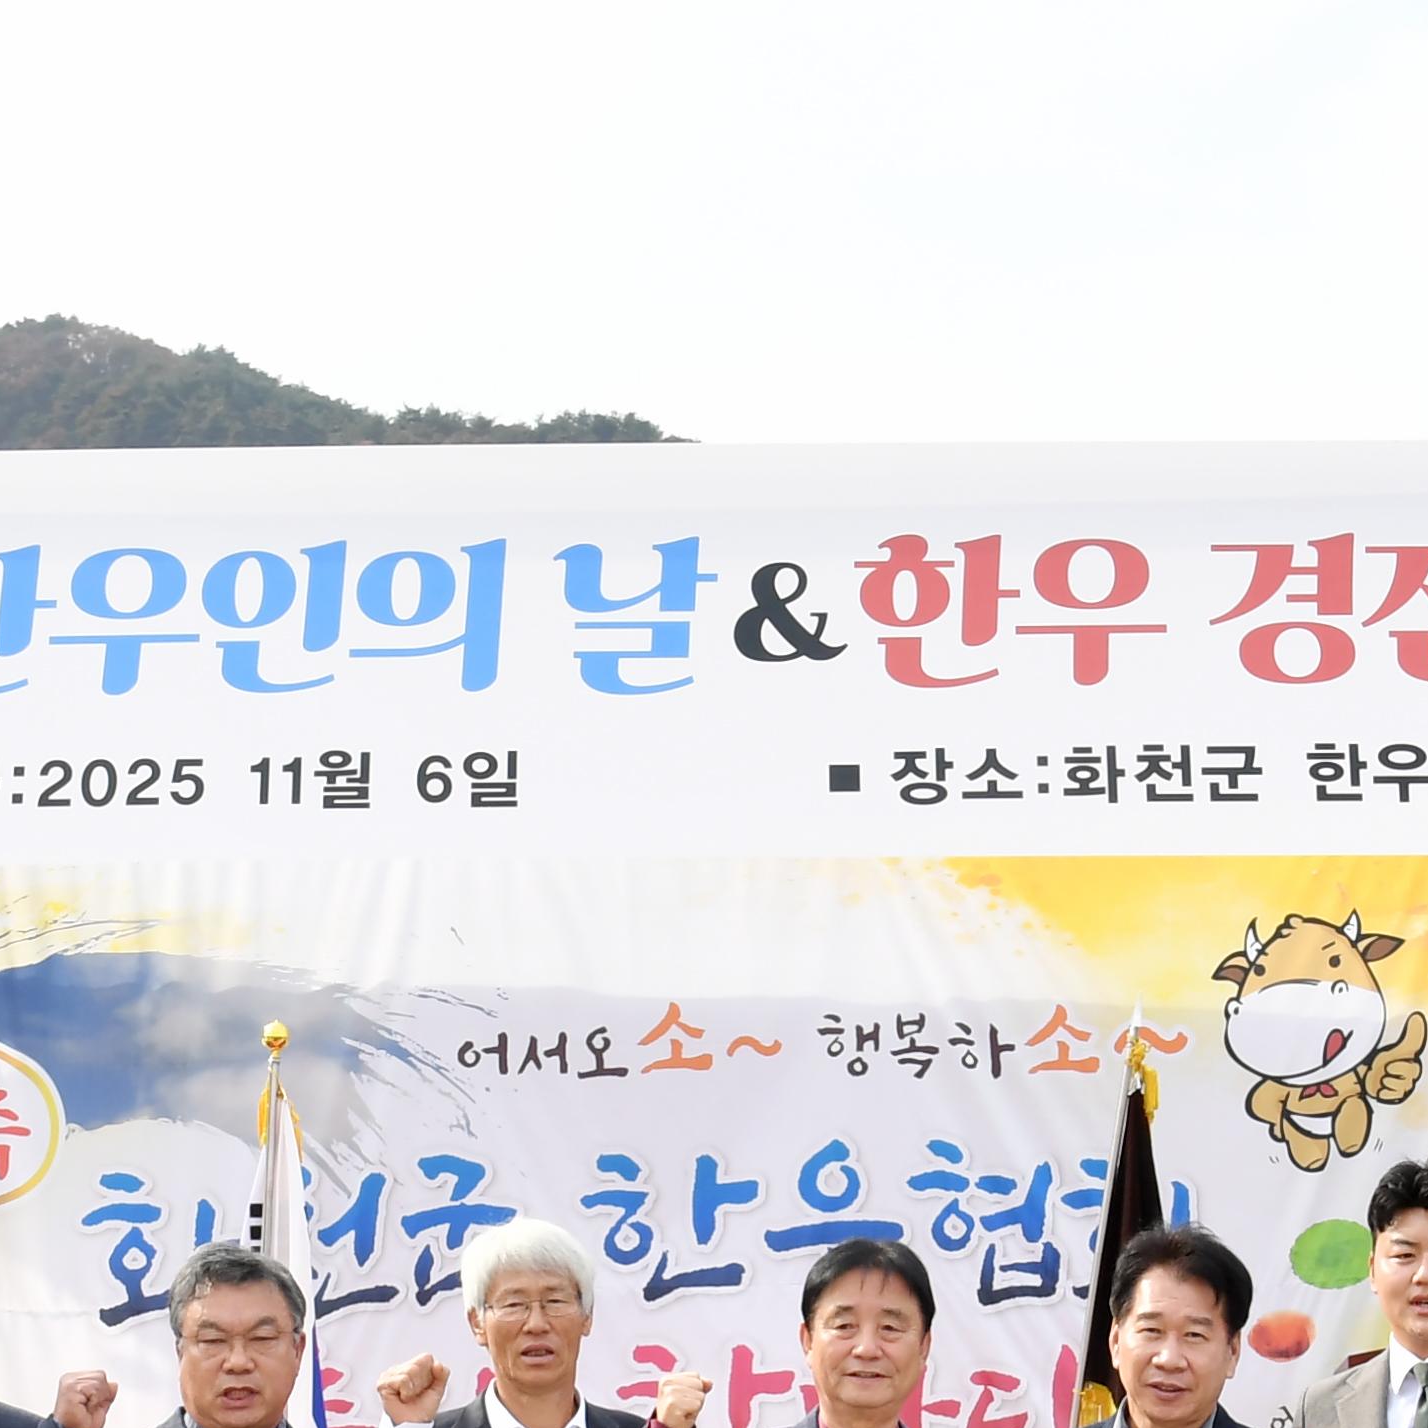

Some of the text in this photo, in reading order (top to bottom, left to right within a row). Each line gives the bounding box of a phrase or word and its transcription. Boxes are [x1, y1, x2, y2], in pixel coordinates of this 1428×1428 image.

[249, 749, 372, 809] 11월
[416, 749, 519, 808] 6일
[891, 743, 1264, 805] 장소:화천군
